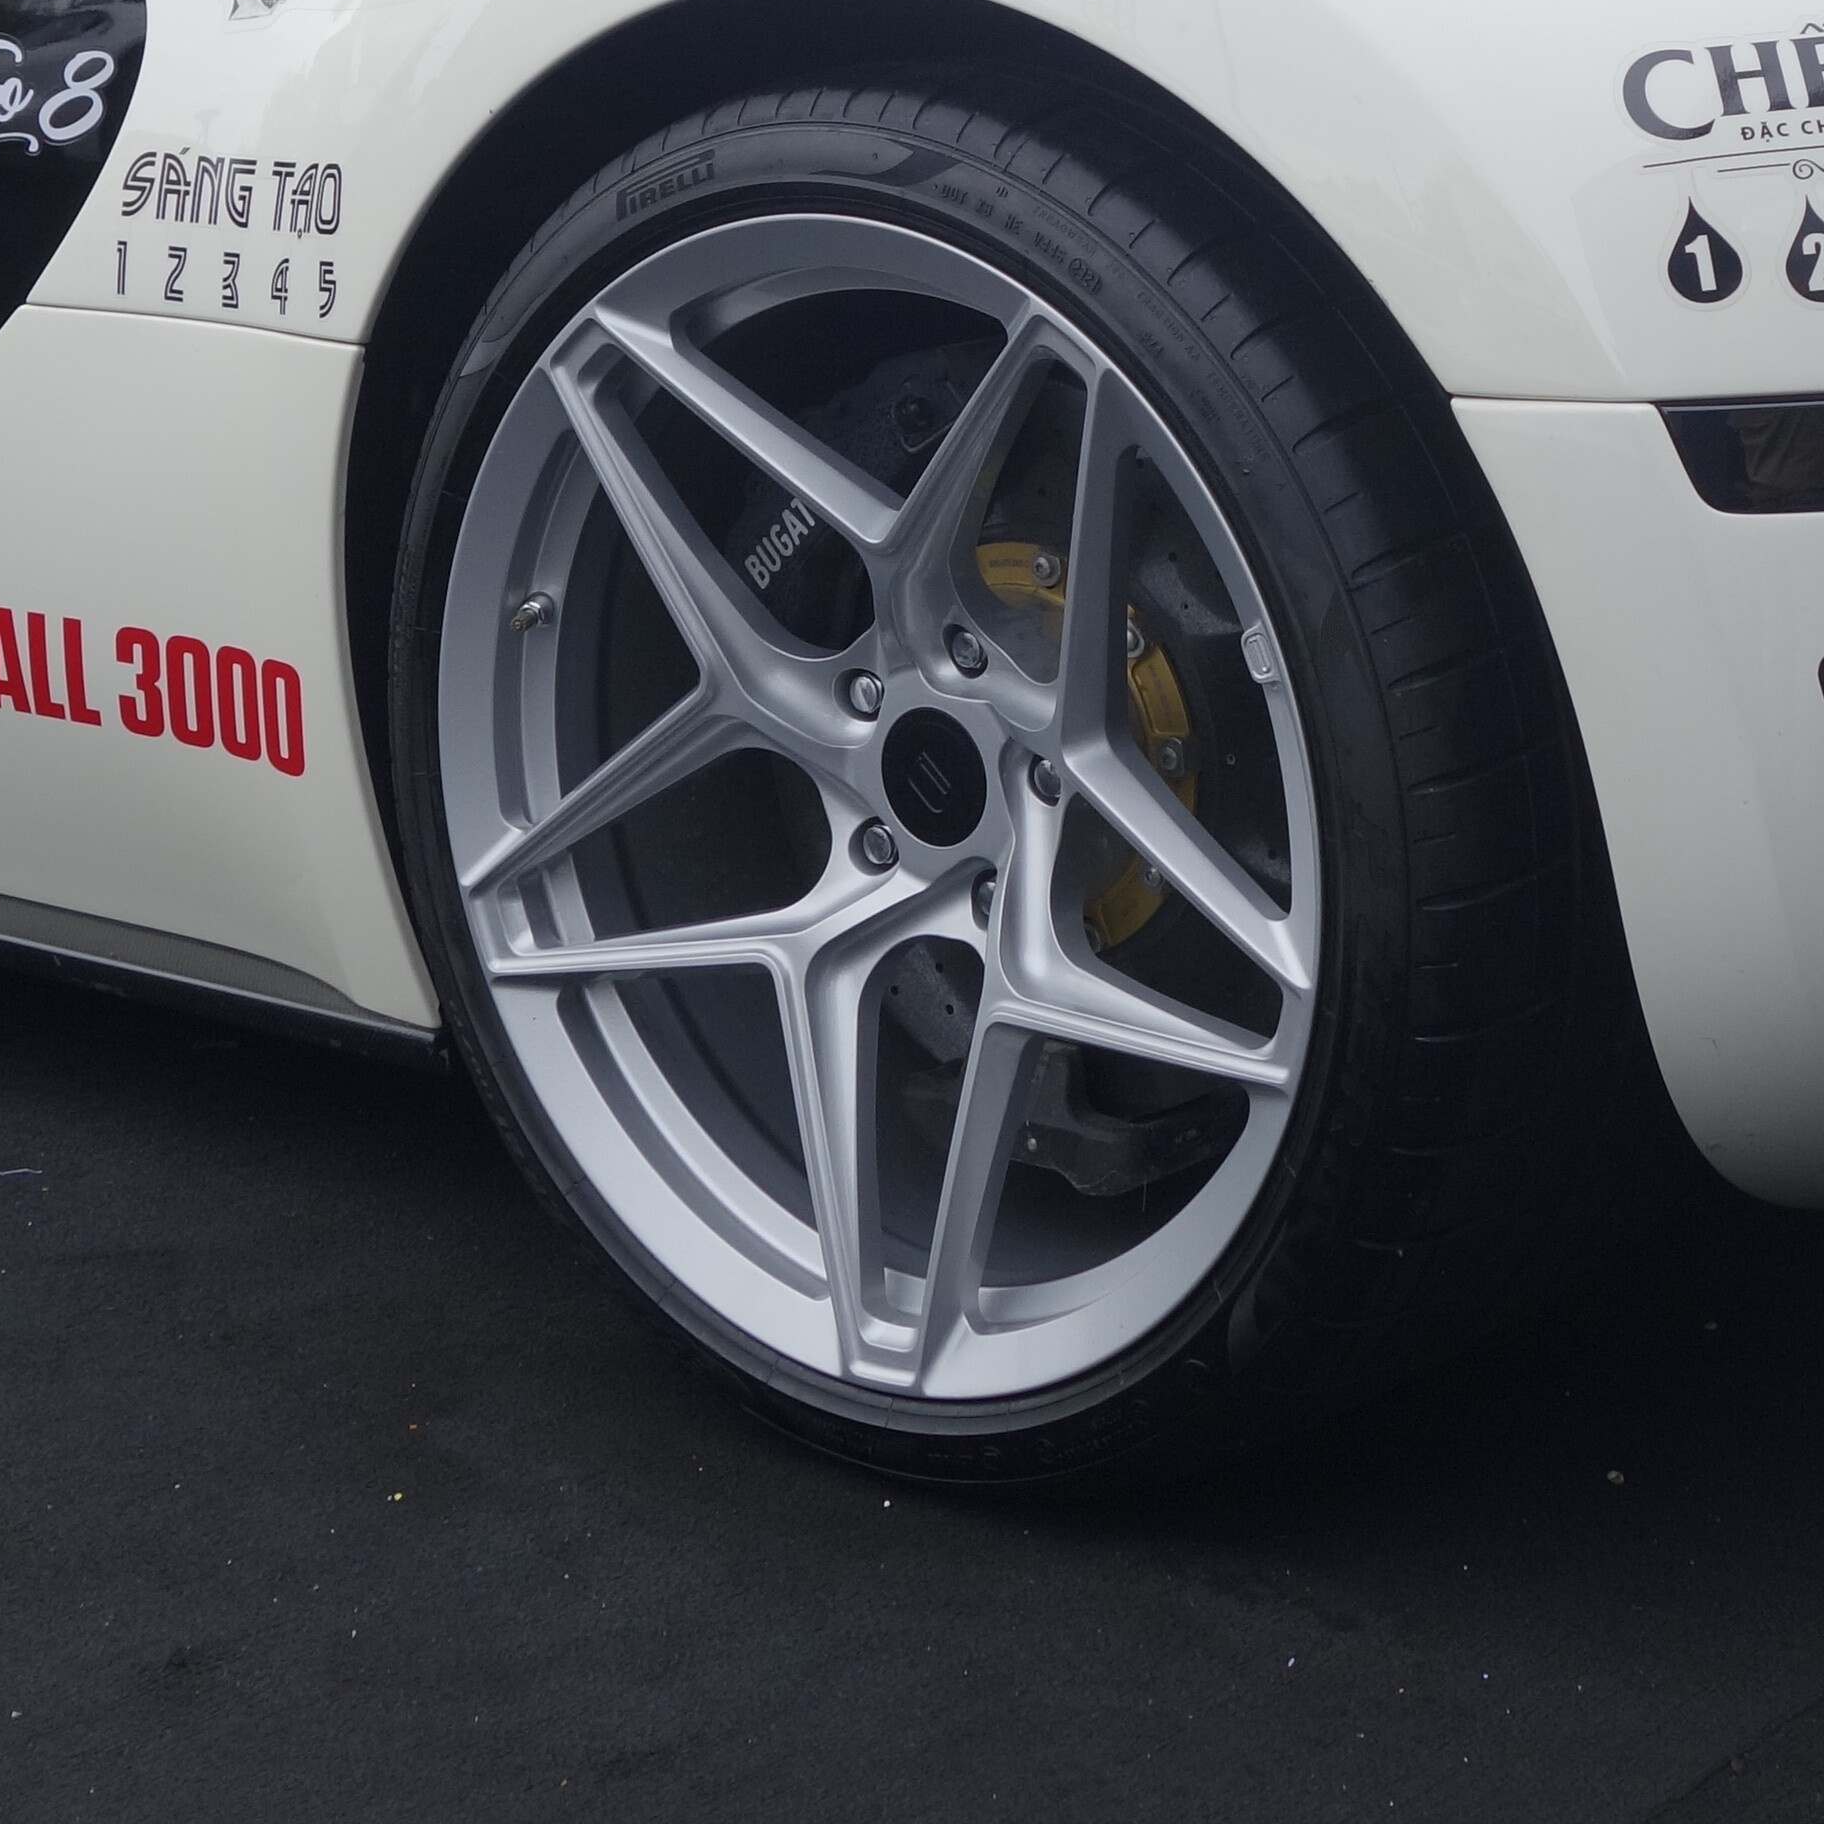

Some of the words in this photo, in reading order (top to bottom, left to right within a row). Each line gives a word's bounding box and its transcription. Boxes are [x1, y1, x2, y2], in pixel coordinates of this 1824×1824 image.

[38, 49, 115, 141] 8
[1741, 120, 1790, 143] ĐẶC
[120, 146, 258, 229] SÁNG
[272, 160, 343, 240] TẠO
[616, 148, 716, 222] PIRELLI
[116, 239, 127, 296] 1
[163, 246, 188, 303] 2
[221, 252, 241, 310] 3
[271, 258, 290, 316] 4
[318, 261, 337, 320] 5
[1684, 234, 1717, 292] 1
[744, 497, 816, 590] BUGAT
[114, 625, 306, 778] 3000
